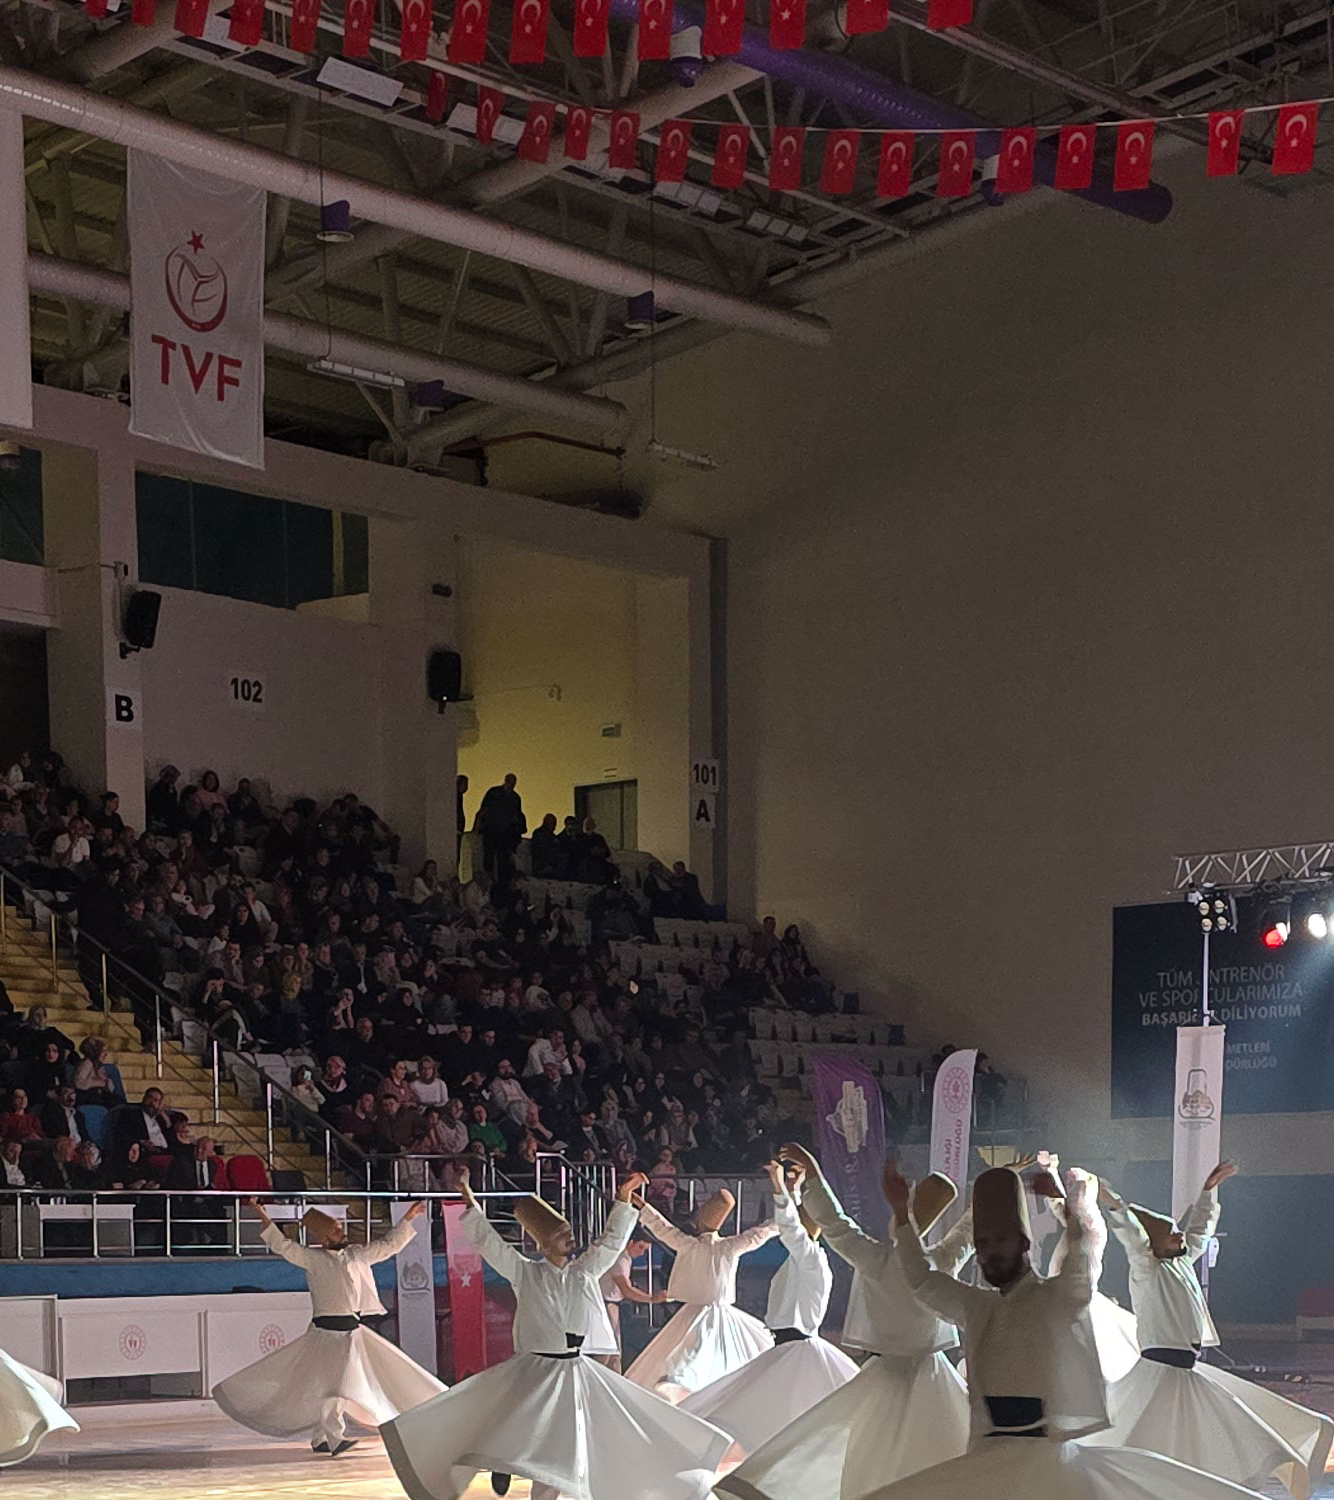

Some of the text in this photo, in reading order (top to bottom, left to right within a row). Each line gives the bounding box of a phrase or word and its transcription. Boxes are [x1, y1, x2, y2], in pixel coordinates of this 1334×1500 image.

[151, 334, 242, 402] TVF
[230, 677, 263, 704] 102
[114, 694, 134, 723] B
[693, 763, 717, 786] 101
[695, 798, 711, 823] A
[1157, 963, 1285, 989] TÜM NTRENÖR
[1138, 991, 1159, 1009] VE
[1220, 1003, 1302, 1022] DİLİYORUM
